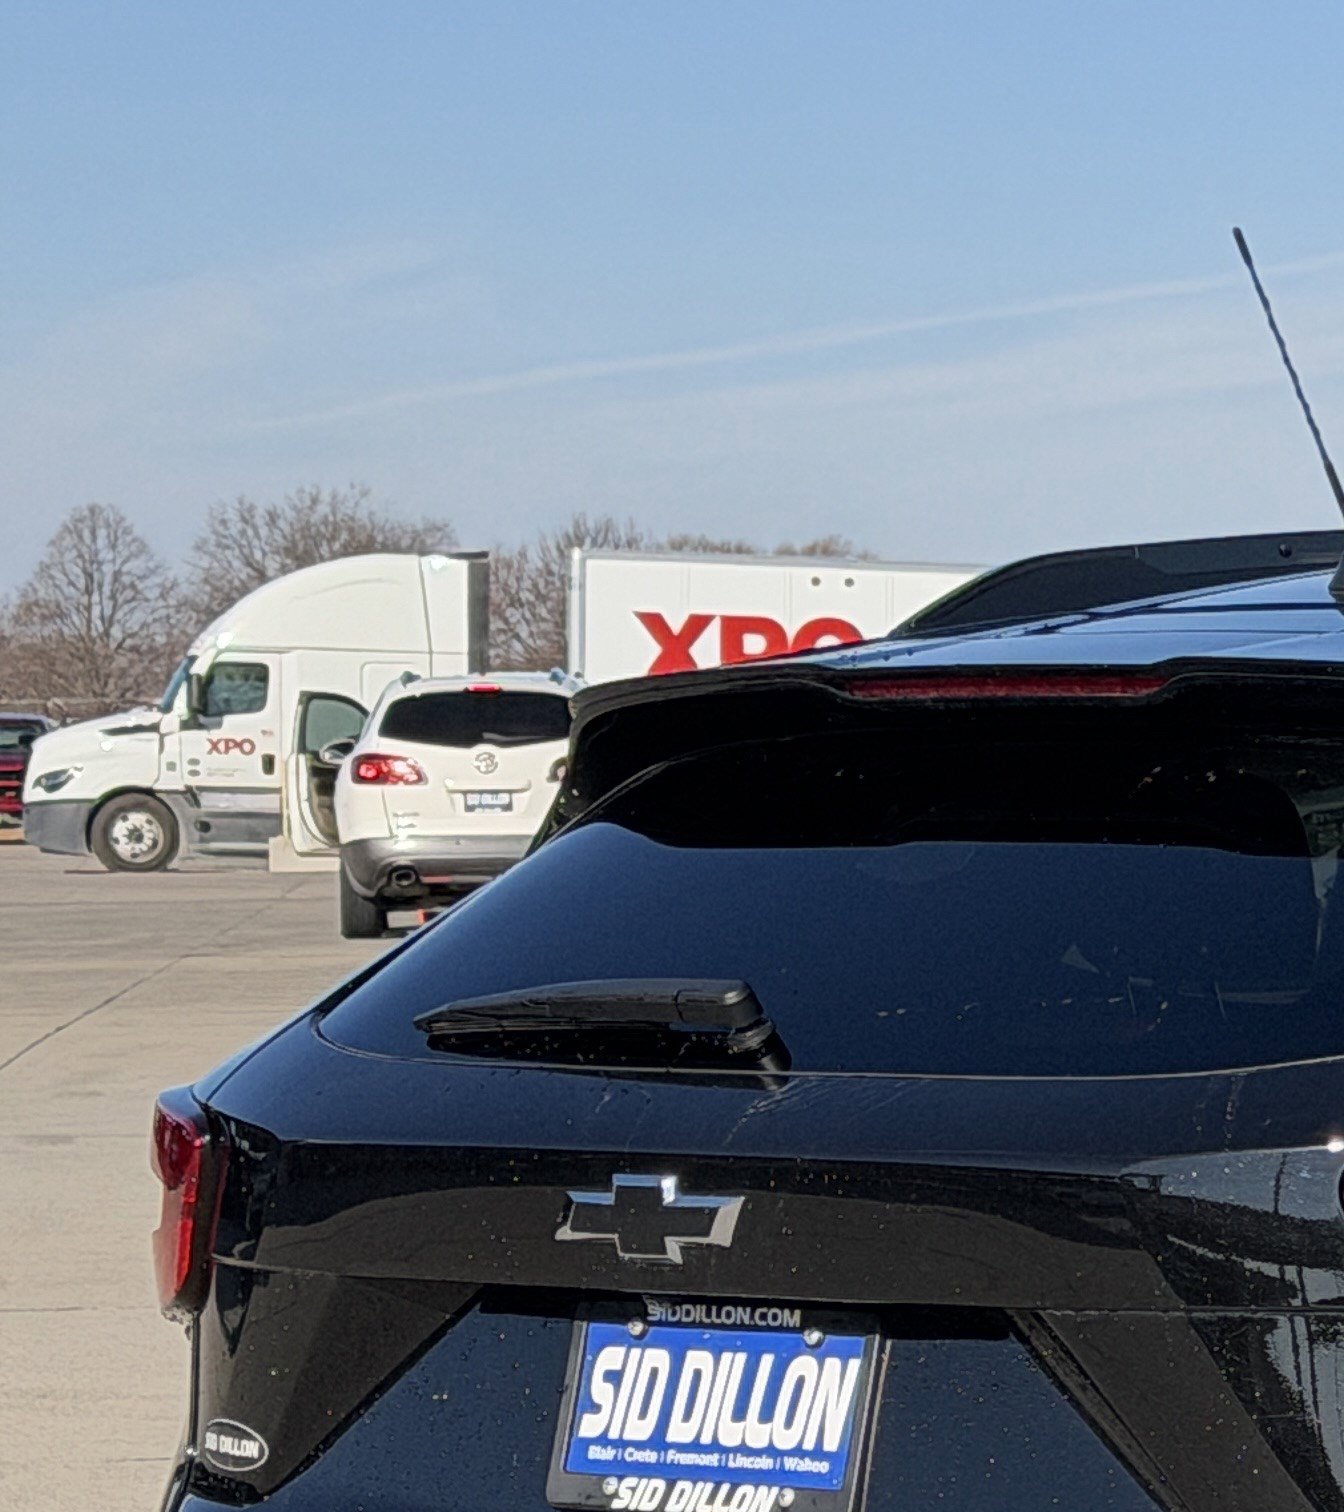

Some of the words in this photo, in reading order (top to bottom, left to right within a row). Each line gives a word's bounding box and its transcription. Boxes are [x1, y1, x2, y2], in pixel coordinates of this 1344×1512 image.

[206, 737, 256, 756] XPO
[646, 1300, 801, 1328] SIDDILLON.COM
[576, 1345, 671, 1442] SID
[665, 1349, 861, 1453] DILLON
[611, 1476, 667, 1512] SID
